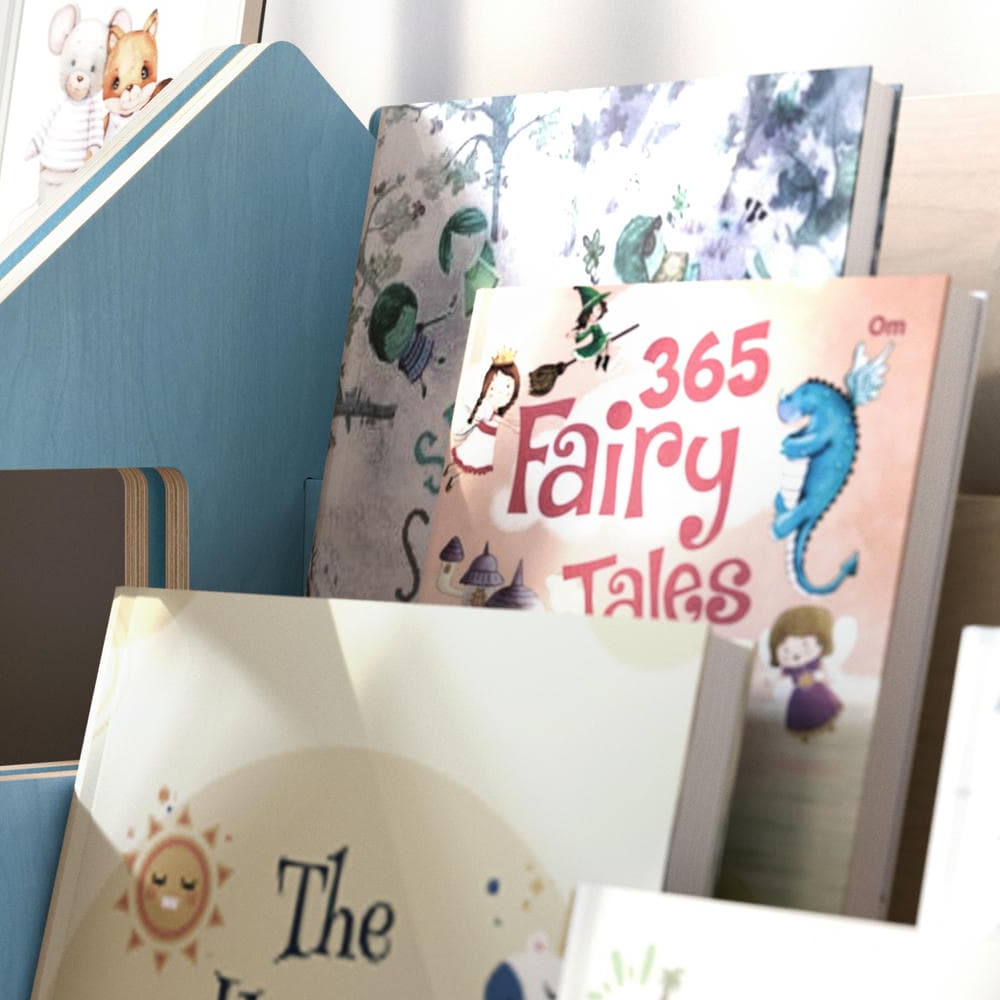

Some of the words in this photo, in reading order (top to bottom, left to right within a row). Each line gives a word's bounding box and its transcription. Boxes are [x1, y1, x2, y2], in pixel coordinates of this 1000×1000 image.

[638, 320, 771, 409] 365
[867, 314, 907, 337] Om
[506, 397, 740, 551] Fairy
[562, 546, 752, 625] Tales
[273, 846, 396, 964] The
